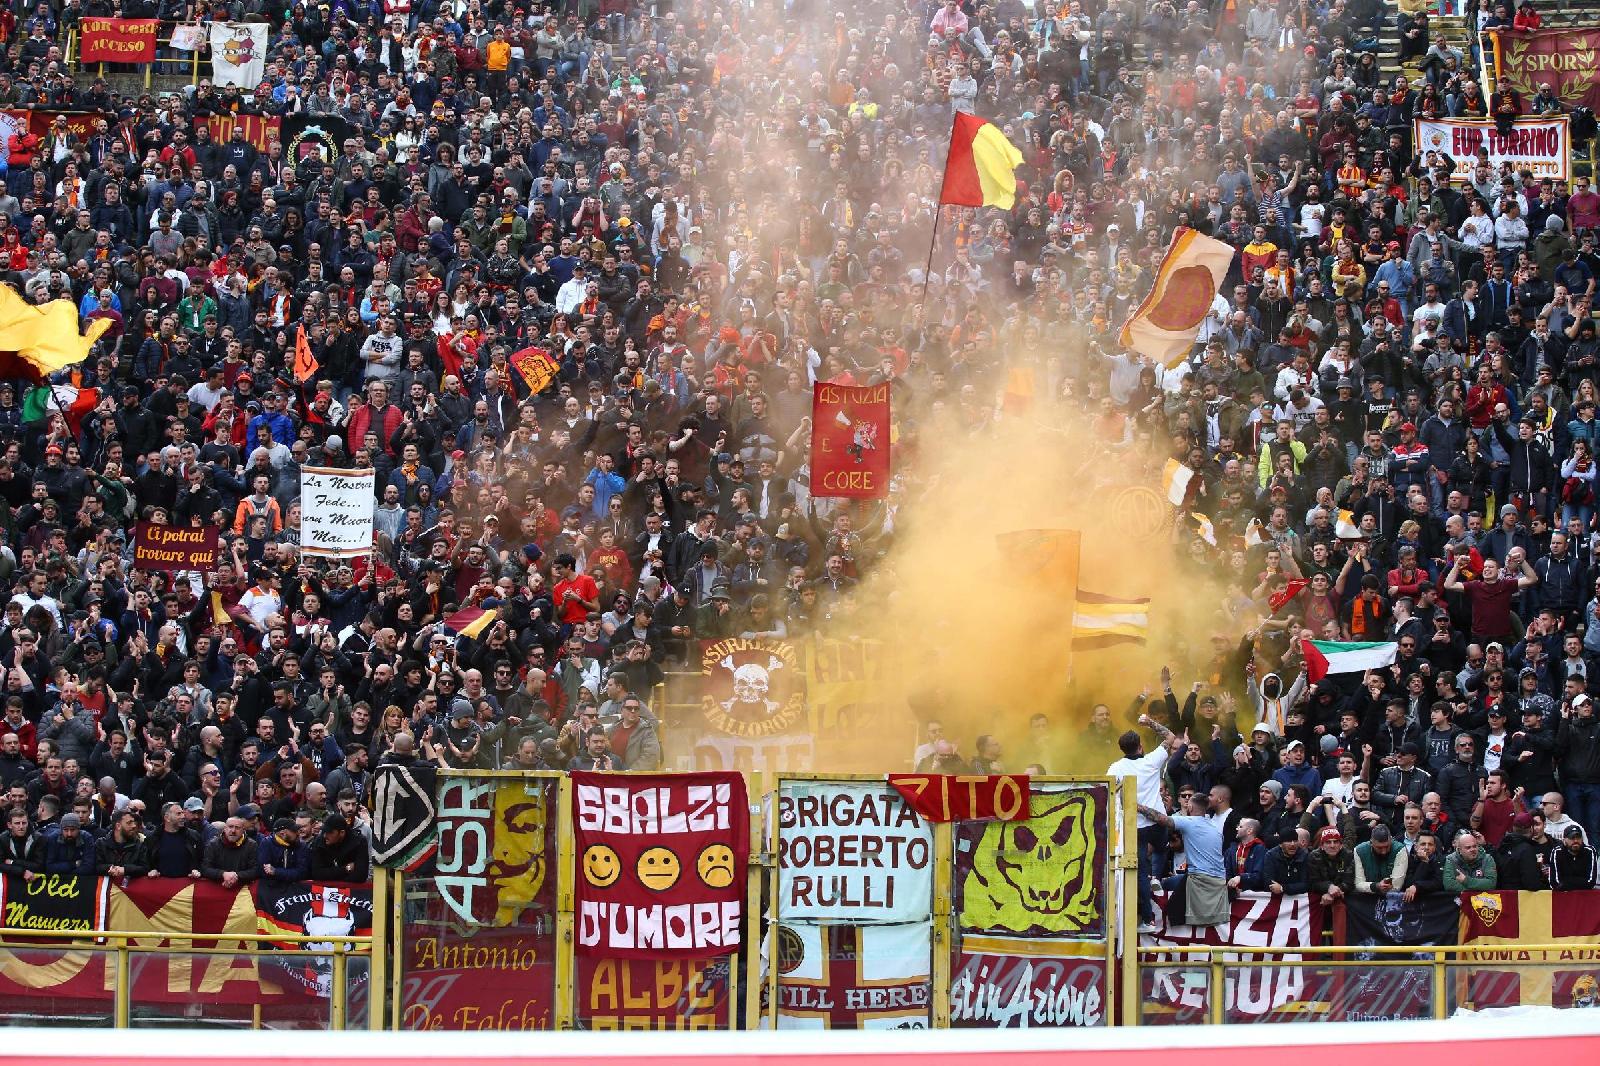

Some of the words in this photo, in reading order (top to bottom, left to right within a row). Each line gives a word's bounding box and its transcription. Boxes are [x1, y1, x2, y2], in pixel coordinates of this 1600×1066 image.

[89, 39, 146, 52] ACCESO
[1525, 54, 1579, 73] SPQR
[1488, 127, 1559, 157] TORRINO
[819, 386, 887, 404] ASTUZIA
[822, 438, 833, 452] E
[302, 475, 323, 488] La
[329, 476, 373, 490] Nostra
[823, 471, 875, 490] CORE
[147, 526, 161, 541] Ci
[161, 528, 206, 545] potrai
[136, 545, 185, 562] trovare
[189, 549, 214, 567] qui
[779, 793, 921, 829] BRIGATA
[434, 777, 490, 926] ASR
[770, 834, 930, 870] ROBERTO
[26, 873, 80, 898] Old
[791, 875, 895, 908] RULLI
[580, 900, 740, 949] D'UMORE
[415, 936, 537, 971] Antonio
[765, 986, 834, 1008] TILL
